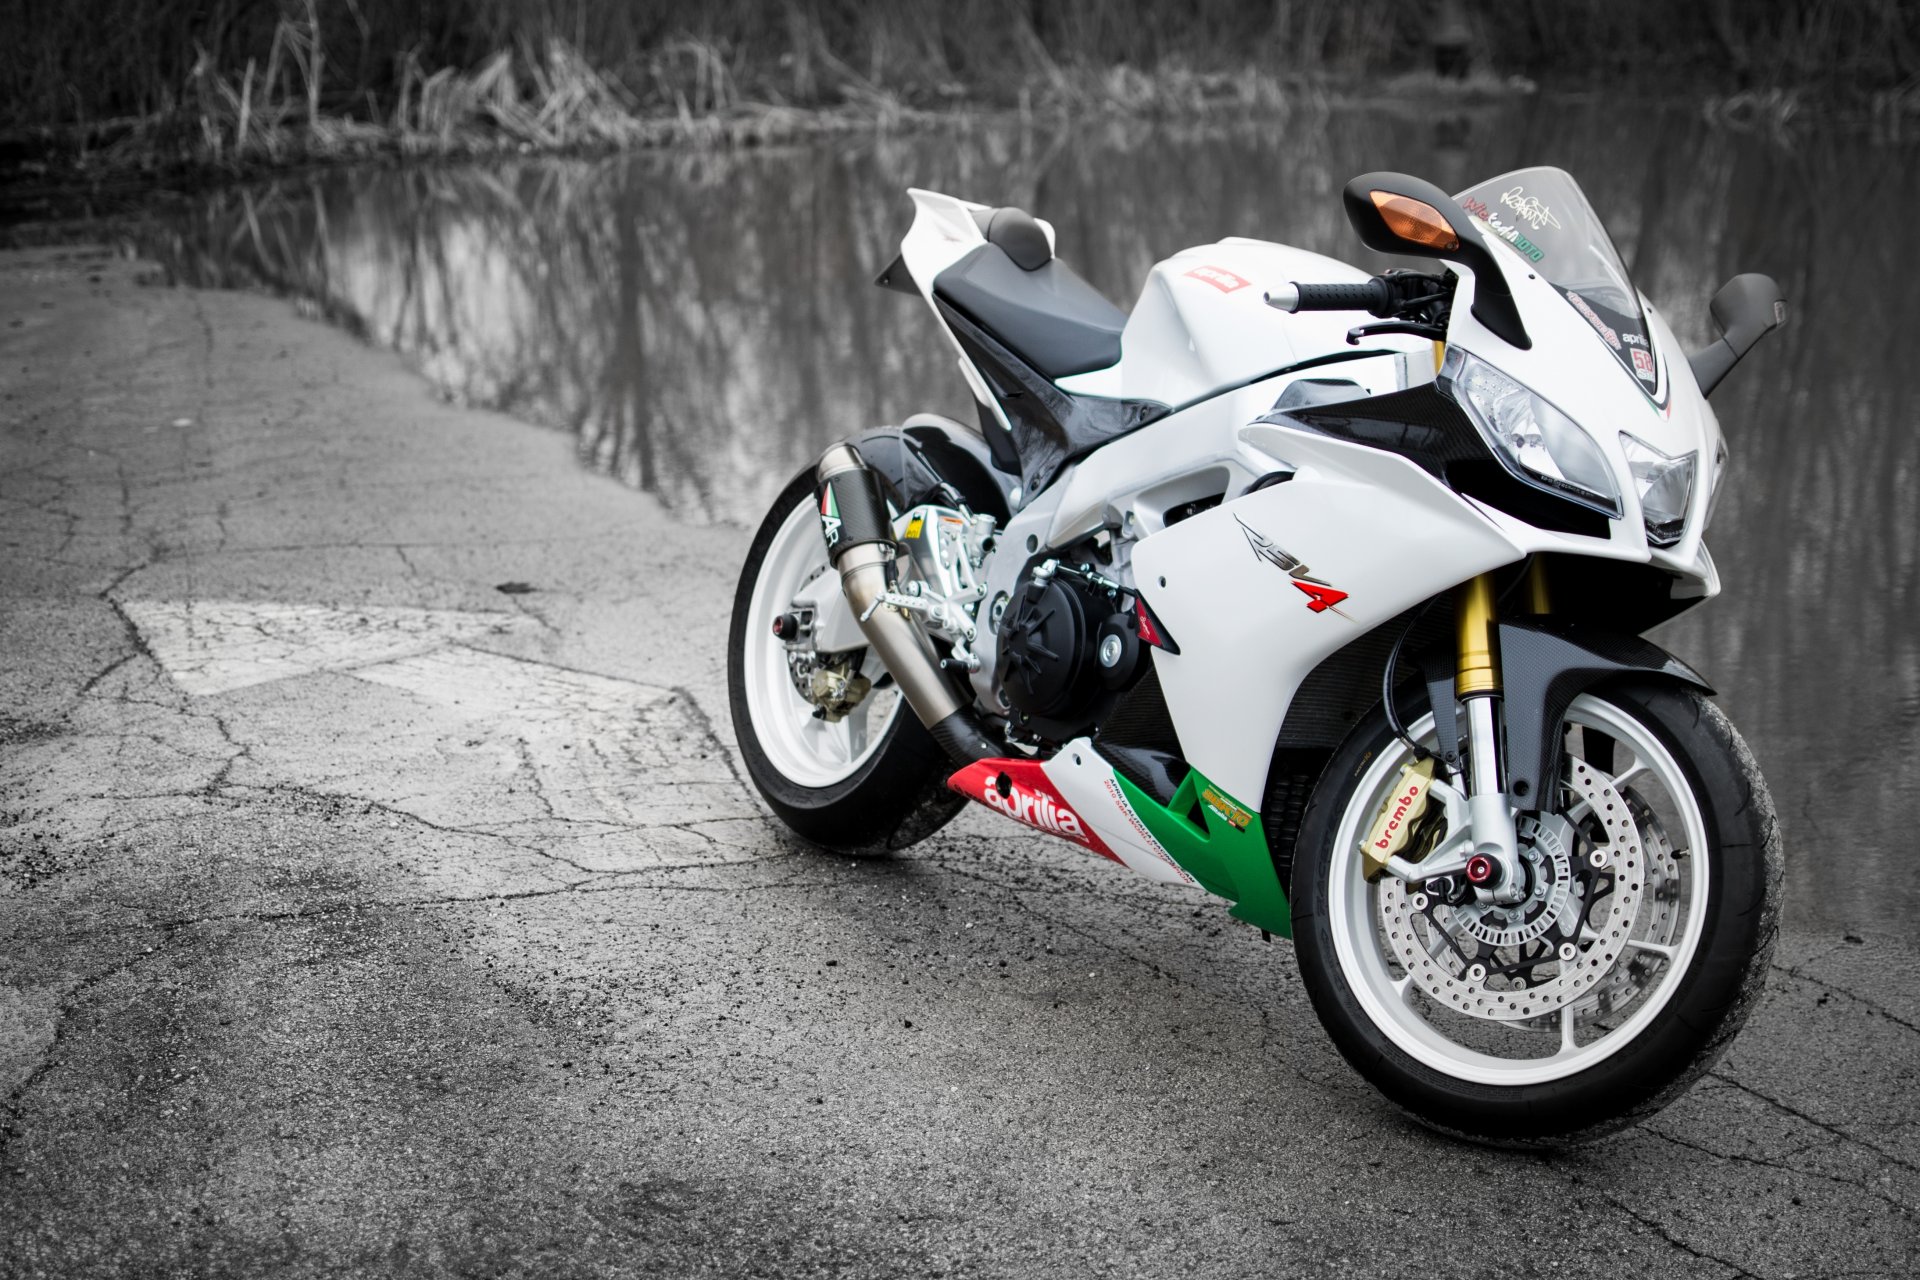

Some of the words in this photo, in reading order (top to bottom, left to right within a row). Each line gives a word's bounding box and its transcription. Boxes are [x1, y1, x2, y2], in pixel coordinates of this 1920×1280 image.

[1103, 779, 1117, 799] 2010
[1115, 800, 1129, 817] SBK
[1128, 818, 1154, 847] WORLD
[1110, 778, 1128, 808] APRILIA
[1127, 808, 1152, 839] ALITALIA
[1375, 786, 1419, 849] brembo
